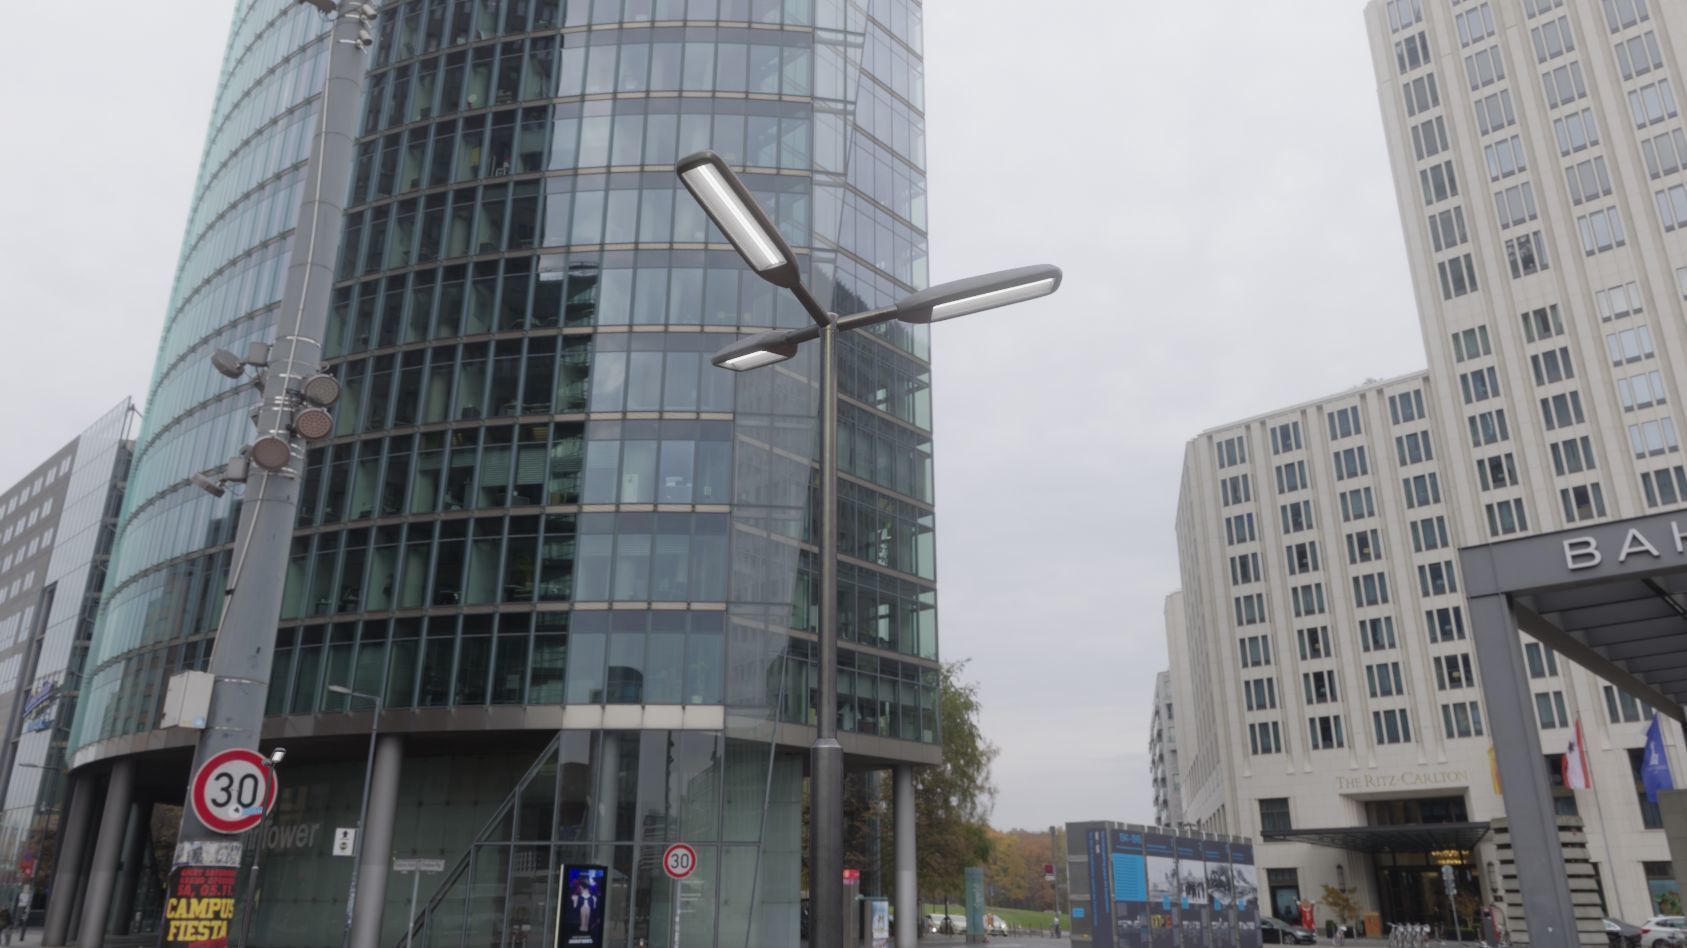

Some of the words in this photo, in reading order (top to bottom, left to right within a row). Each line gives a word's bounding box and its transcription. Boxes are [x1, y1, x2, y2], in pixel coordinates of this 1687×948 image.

[210, 771, 259, 809] 30
[1336, 776, 1362, 790] THE
[670, 853, 690, 869] 30
[165, 897, 235, 919] CAMPUS
[167, 920, 229, 942] FIESTA
